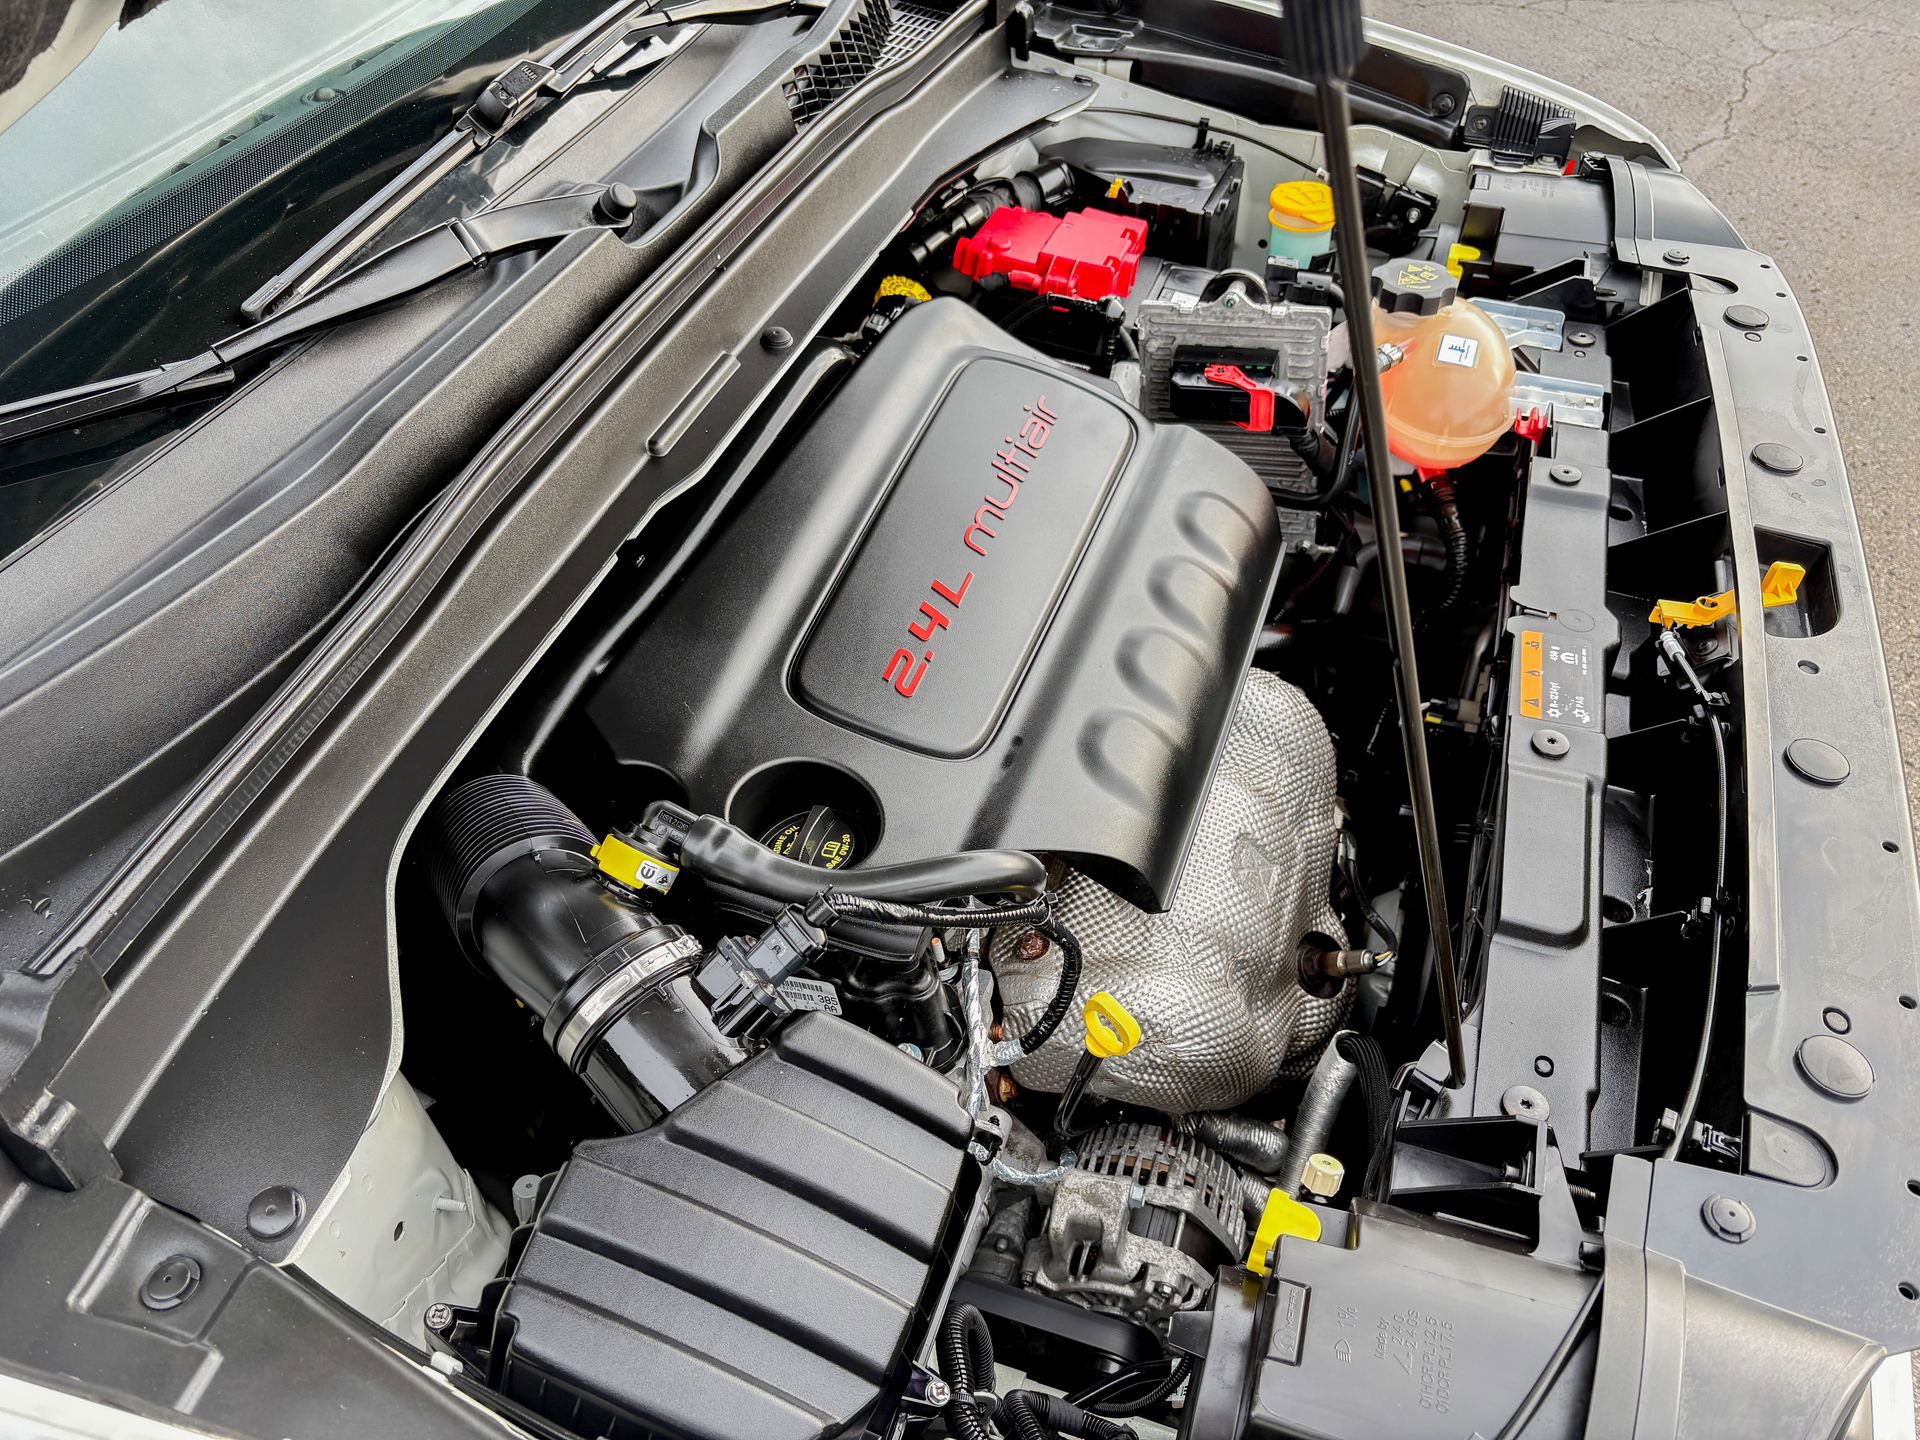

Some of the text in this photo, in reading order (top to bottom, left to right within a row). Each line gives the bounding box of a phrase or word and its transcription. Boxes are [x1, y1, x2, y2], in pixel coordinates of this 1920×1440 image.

[963, 394, 1058, 556] multiair
[773, 825, 800, 854] GINE OIL
[826, 856, 843, 869] SAE
[818, 995, 838, 1006] 385
[824, 1004, 838, 1013] AA
[1336, 1304, 1358, 1328] 1%
[1391, 1314, 1405, 1346] 240
[1405, 1310, 1419, 1350] 240S
